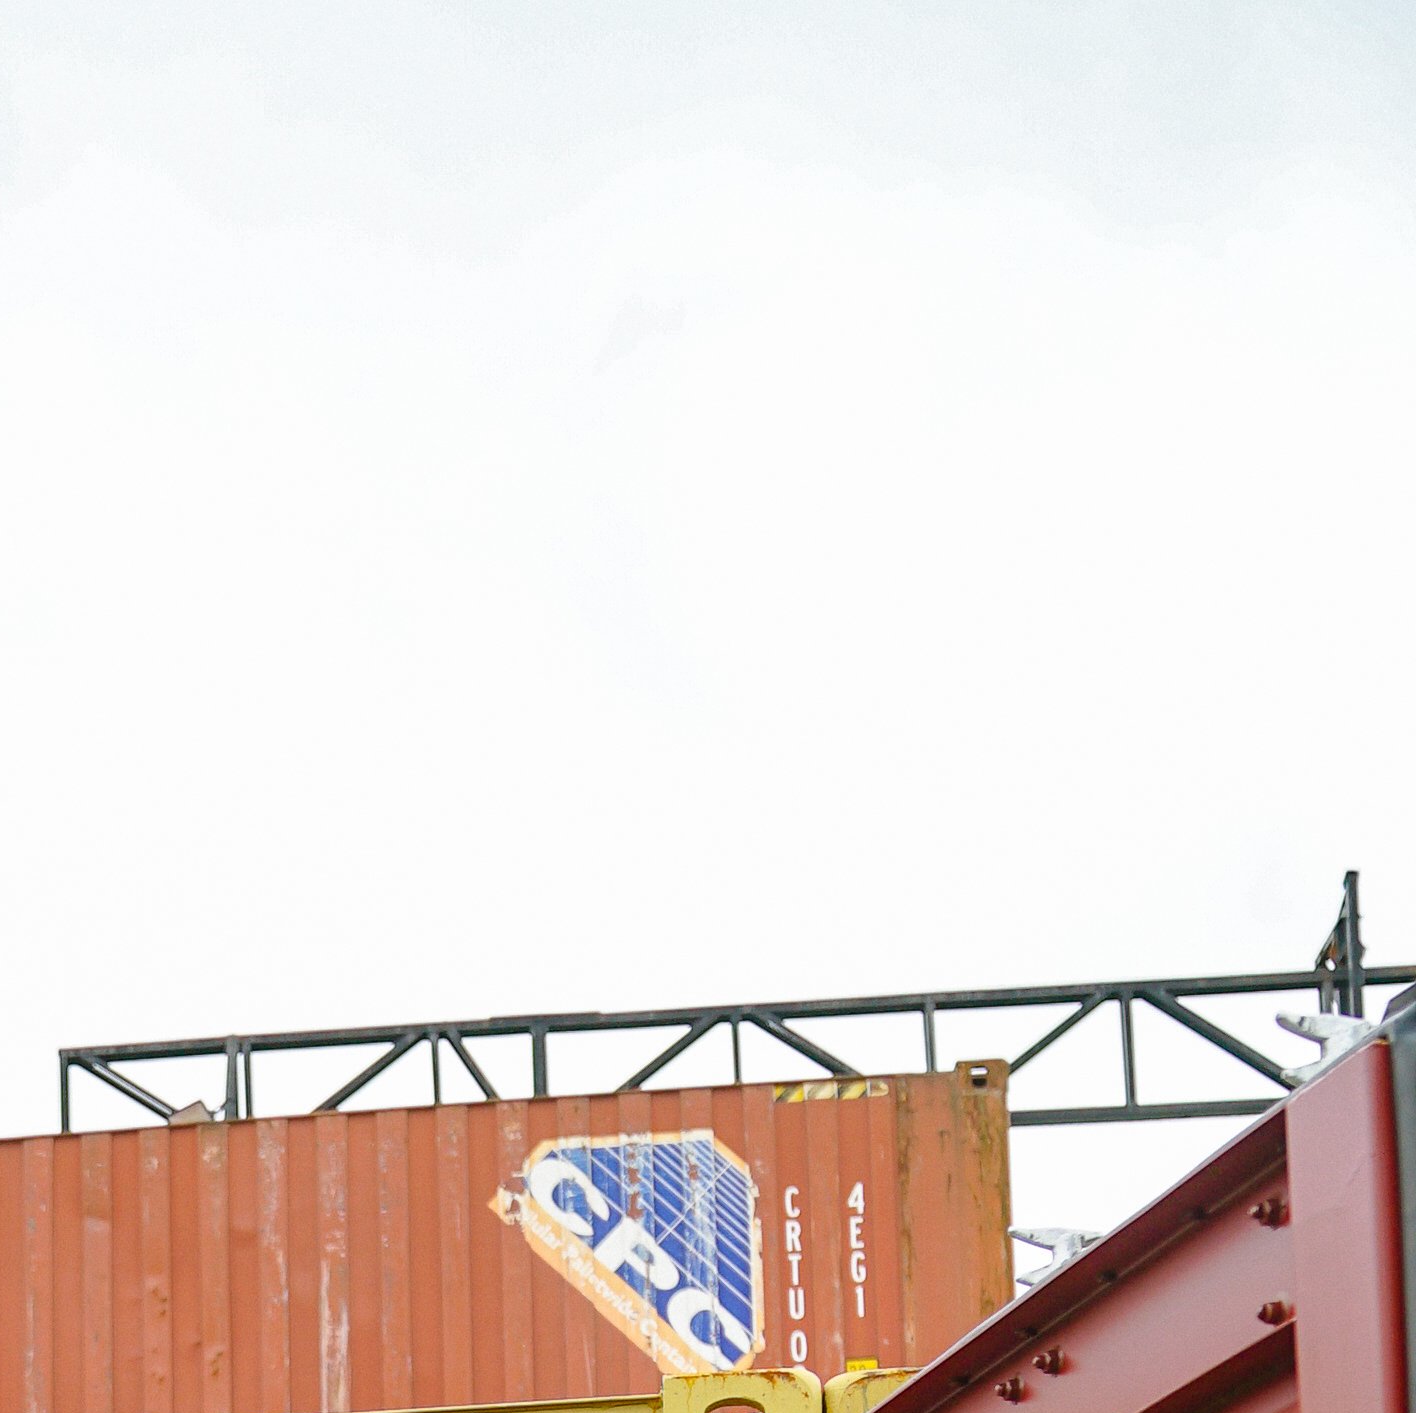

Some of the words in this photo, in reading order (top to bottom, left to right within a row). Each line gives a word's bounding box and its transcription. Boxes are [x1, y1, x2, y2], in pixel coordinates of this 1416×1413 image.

[529, 1158, 751, 1372] CPC
[784, 1185, 805, 1320] CRTU
[847, 1181, 866, 1318] 4EG1
